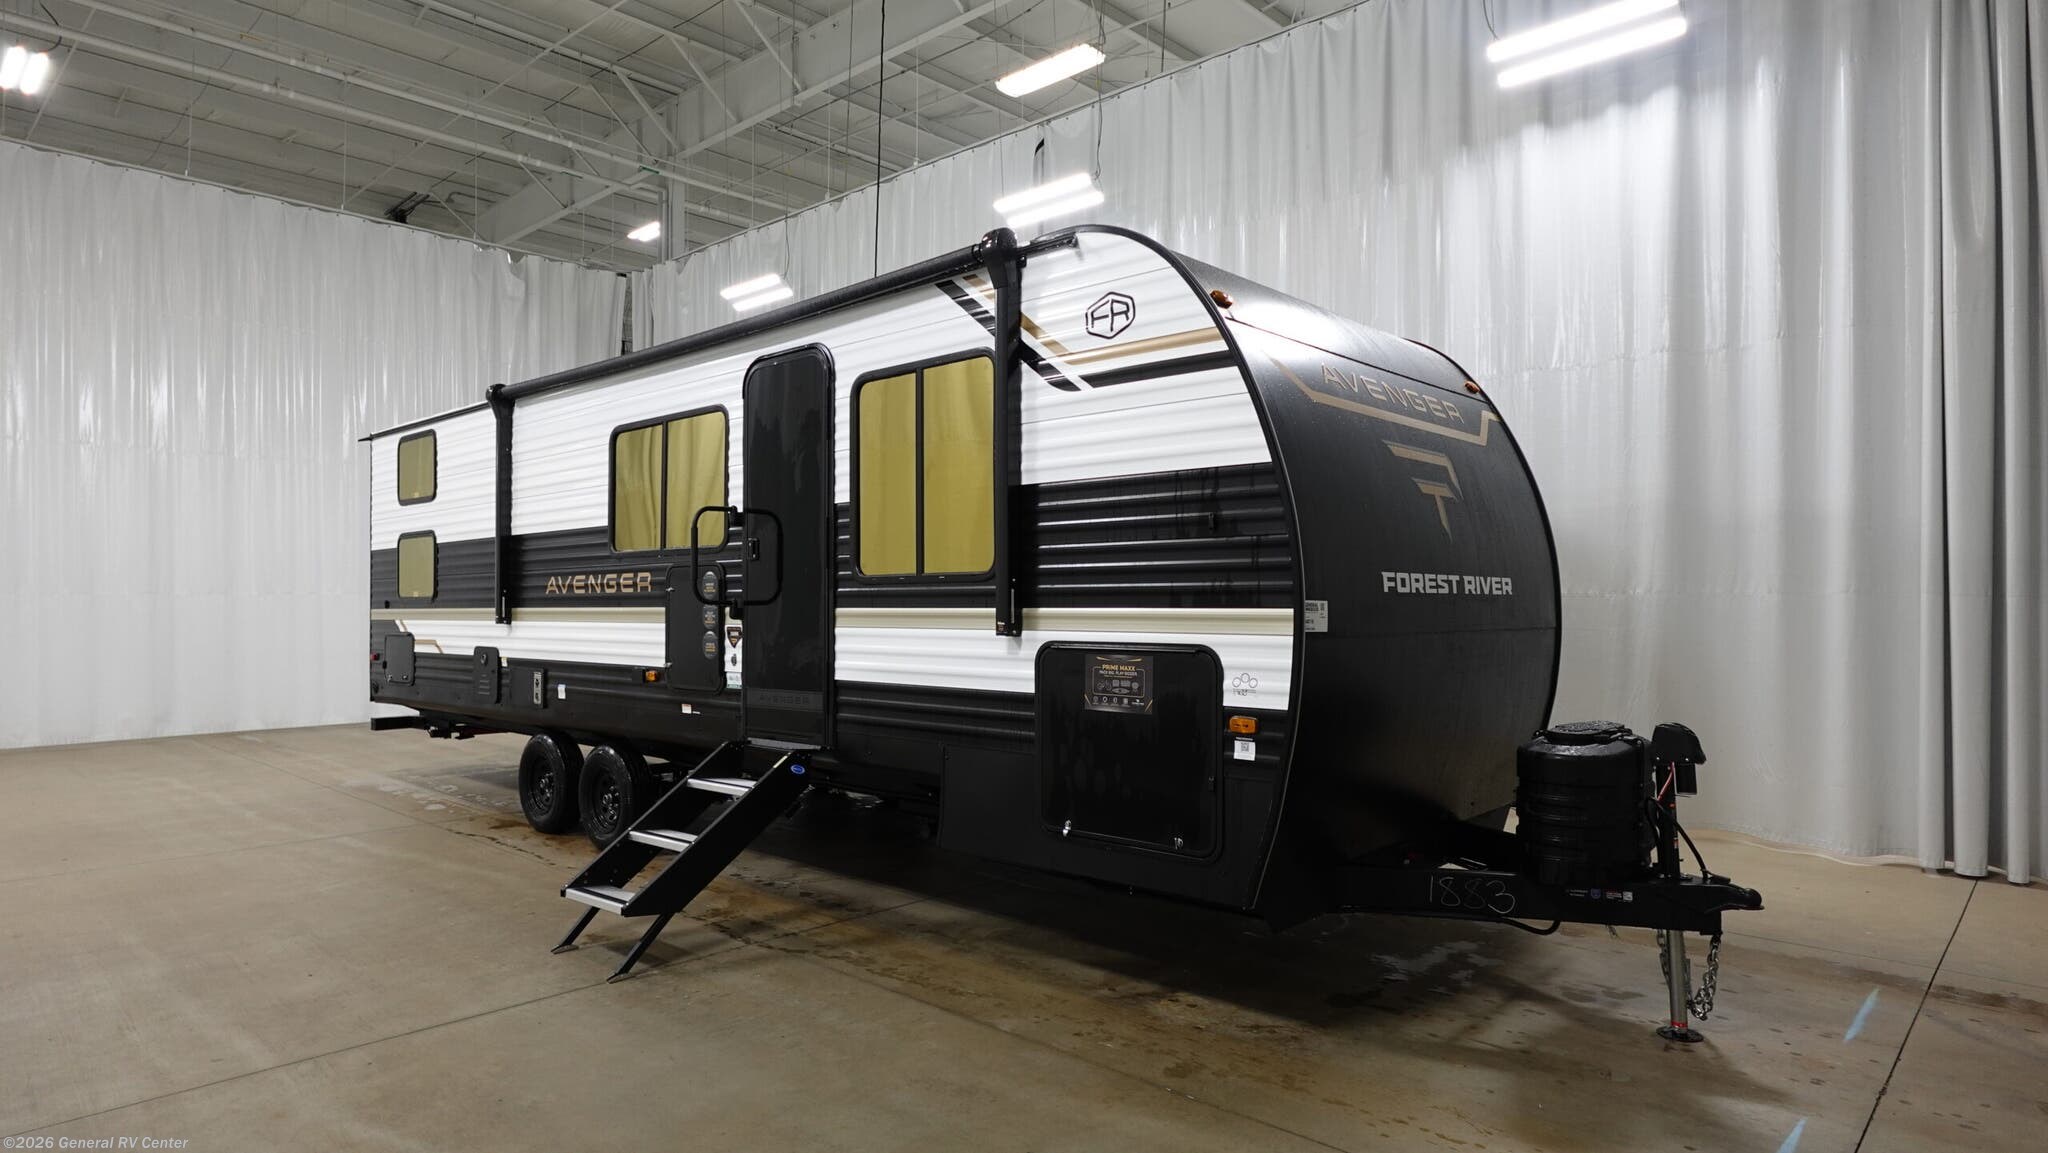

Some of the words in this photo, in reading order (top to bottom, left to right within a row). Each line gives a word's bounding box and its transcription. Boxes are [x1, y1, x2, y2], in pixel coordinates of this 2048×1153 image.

[1321, 362, 1464, 424] AVENGER
[545, 571, 652, 595] AVENGER
[1381, 571, 1460, 594] FOREST
[1462, 575, 1513, 595] RIVER
[1429, 875, 1516, 914] 1883
